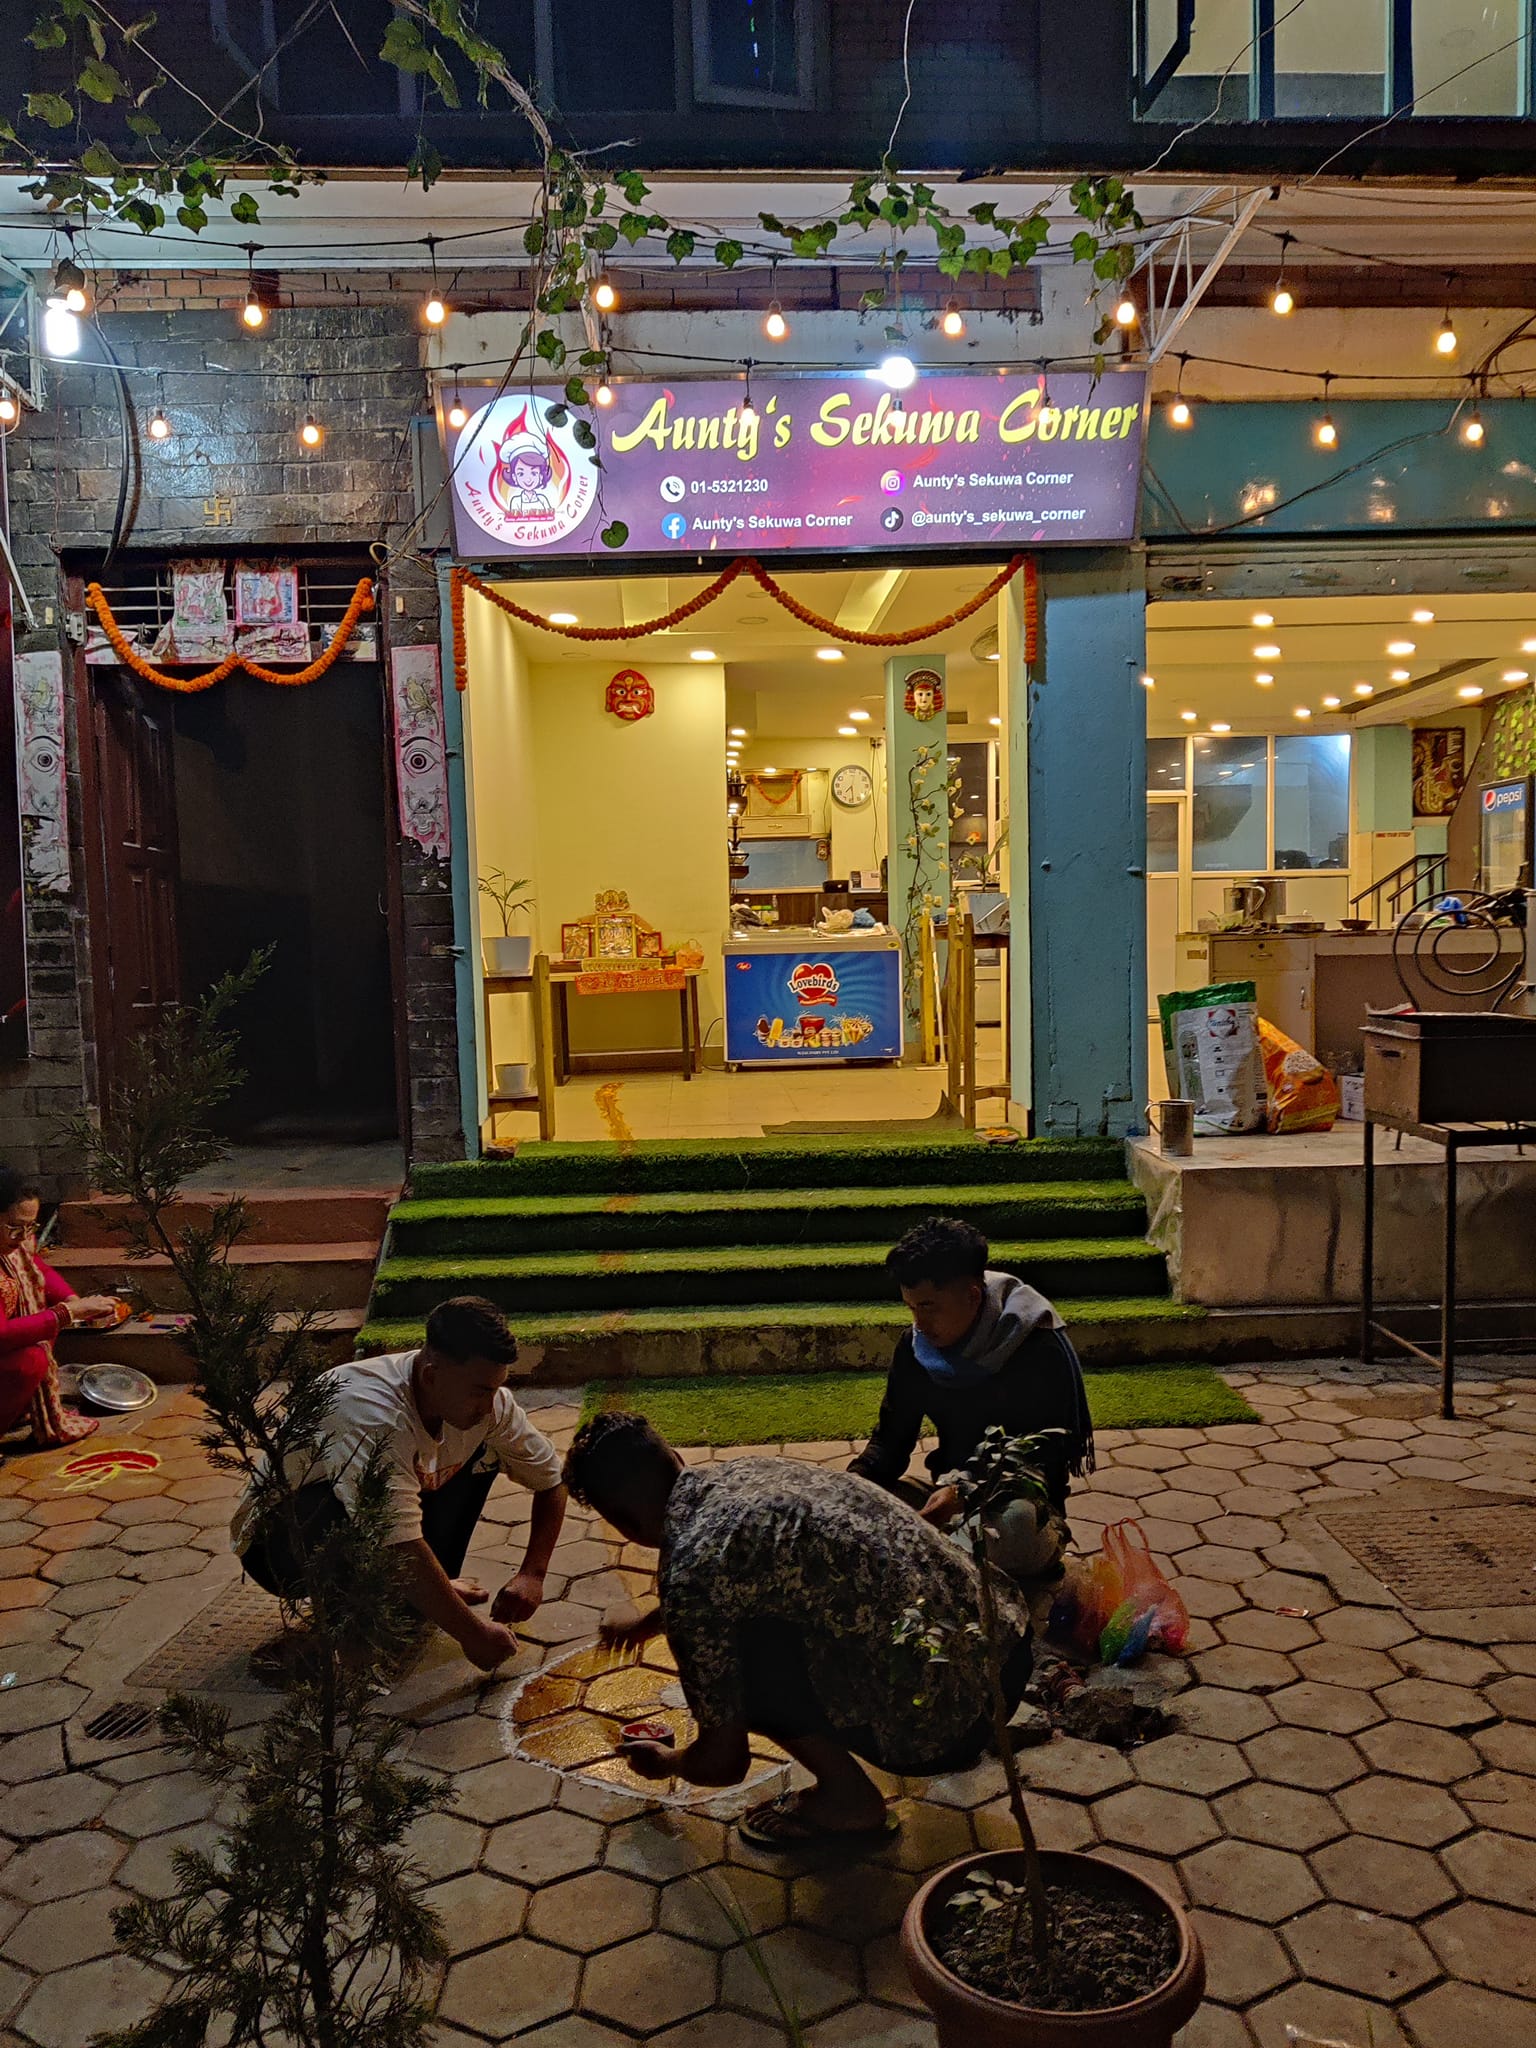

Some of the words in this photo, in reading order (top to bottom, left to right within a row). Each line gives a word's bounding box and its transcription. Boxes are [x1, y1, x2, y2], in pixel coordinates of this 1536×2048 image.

[611, 394, 792, 462] Aunty's
[809, 391, 980, 447] Sekuwa
[998, 388, 1139, 443] Corner
[690, 478, 769, 494] 01-5321230
[912, 474, 966, 490] Aunty's
[968, 473, 1023, 487] Sekuwa
[1025, 471, 1074, 485] Corner
[465, 481, 503, 531] Aunty's
[514, 521, 566, 541] Sekuwa
[566, 474, 589, 519] Corner
[692, 517, 745, 533] Aunty's
[748, 515, 802, 529] Sekuwa
[805, 513, 853, 527] Corner
[911, 508, 1086, 528] @aunty's_sekuwa_corner
[1496, 787, 1524, 808] pepsi
[789, 975, 838, 991] Lovebirds
